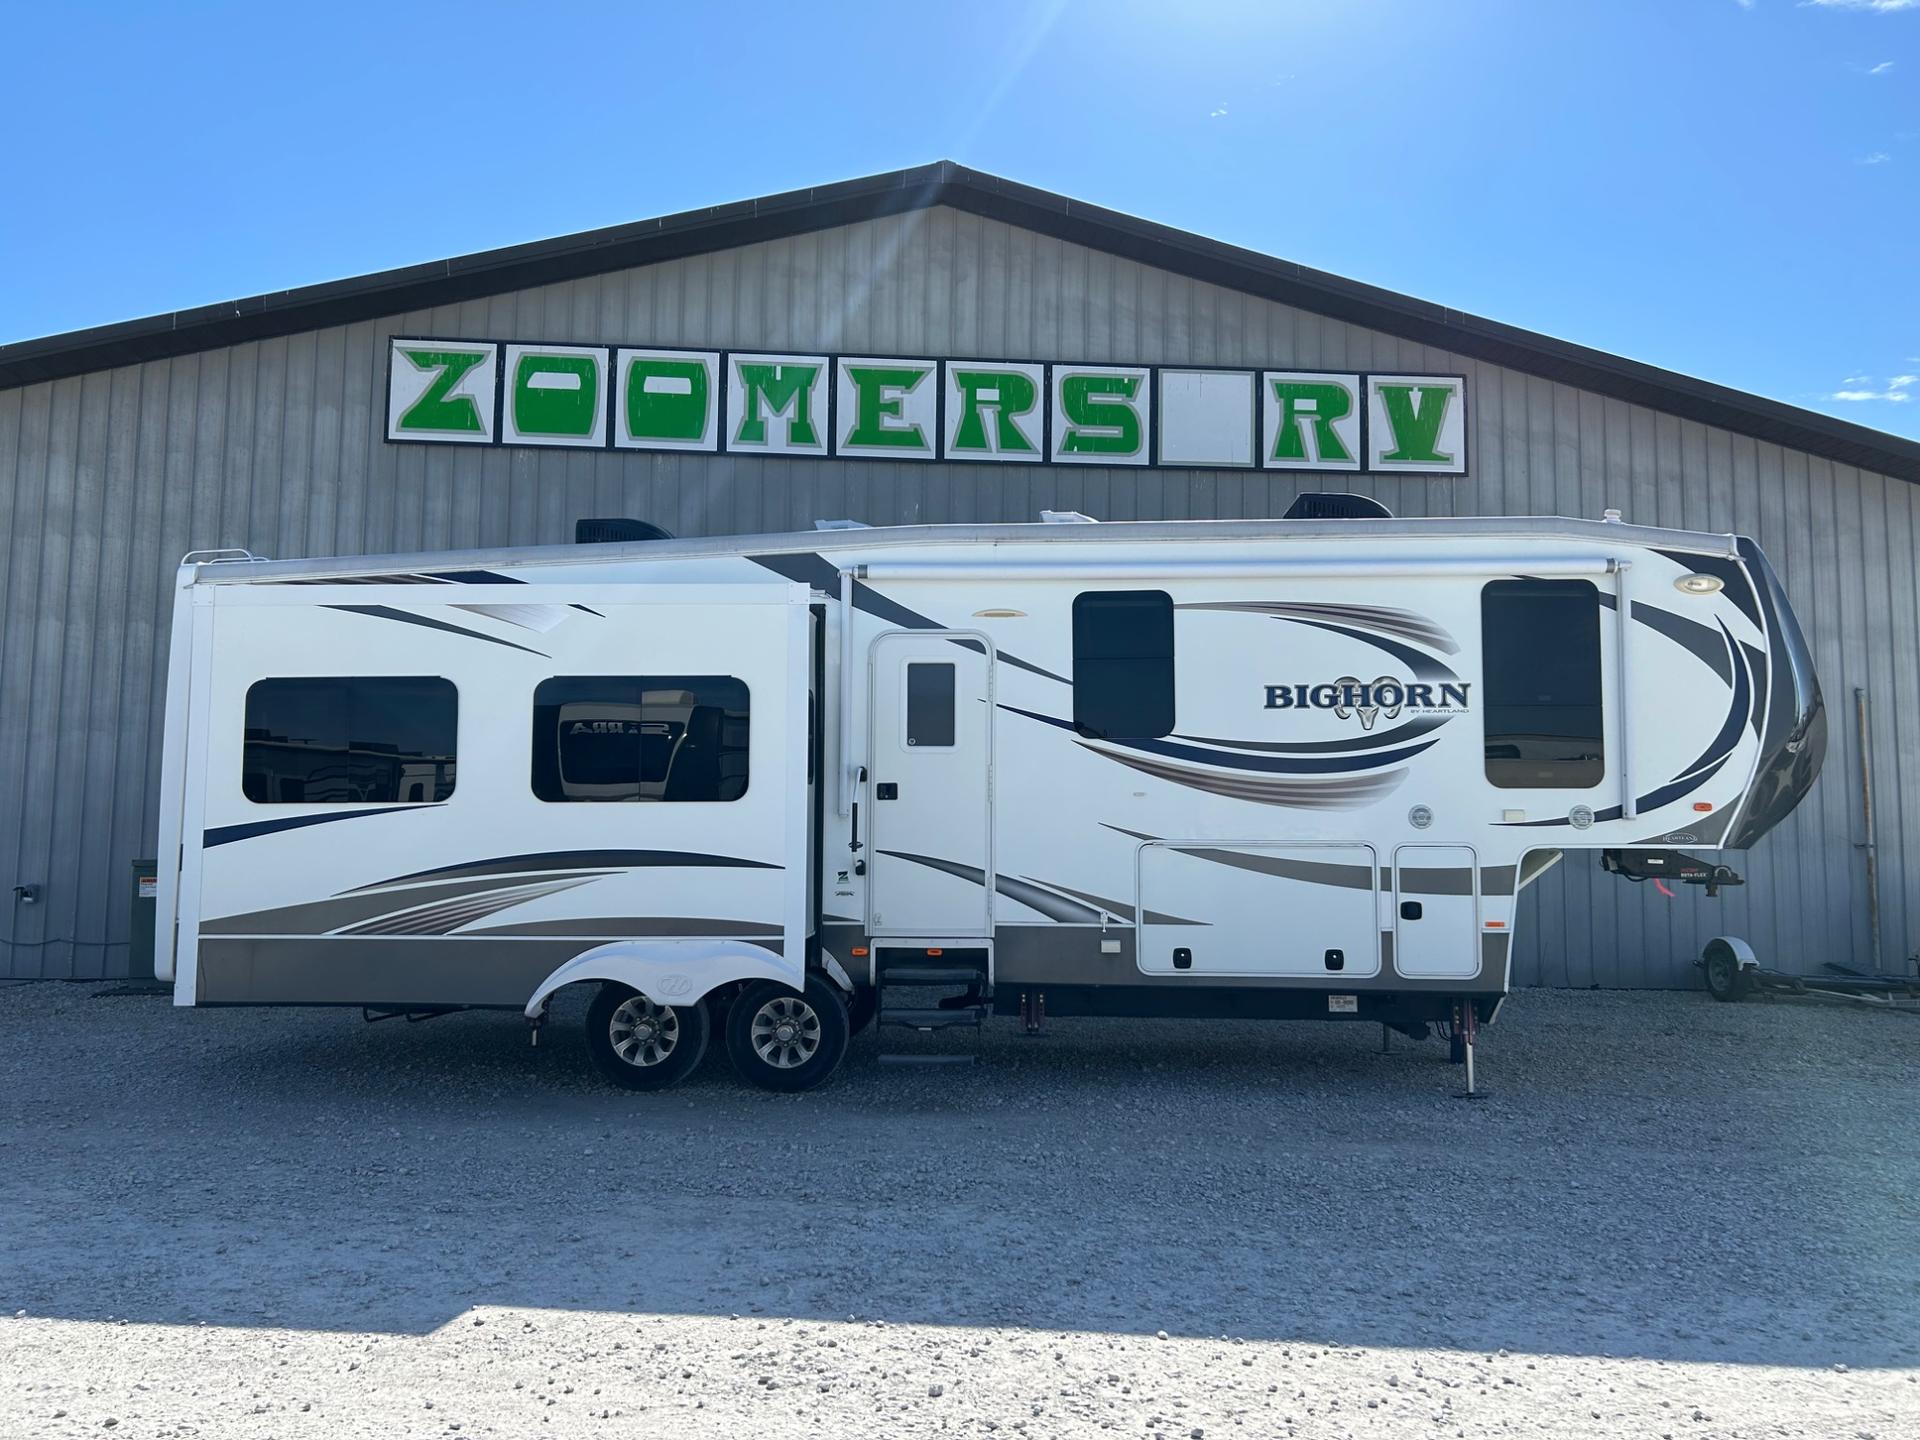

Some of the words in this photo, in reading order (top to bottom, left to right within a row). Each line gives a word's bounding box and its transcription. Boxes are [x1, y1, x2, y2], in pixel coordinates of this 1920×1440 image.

[394, 346, 1144, 457] ZOOMERS
[1269, 378, 1459, 466] RV
[1264, 682, 1472, 710] BIGHORN
